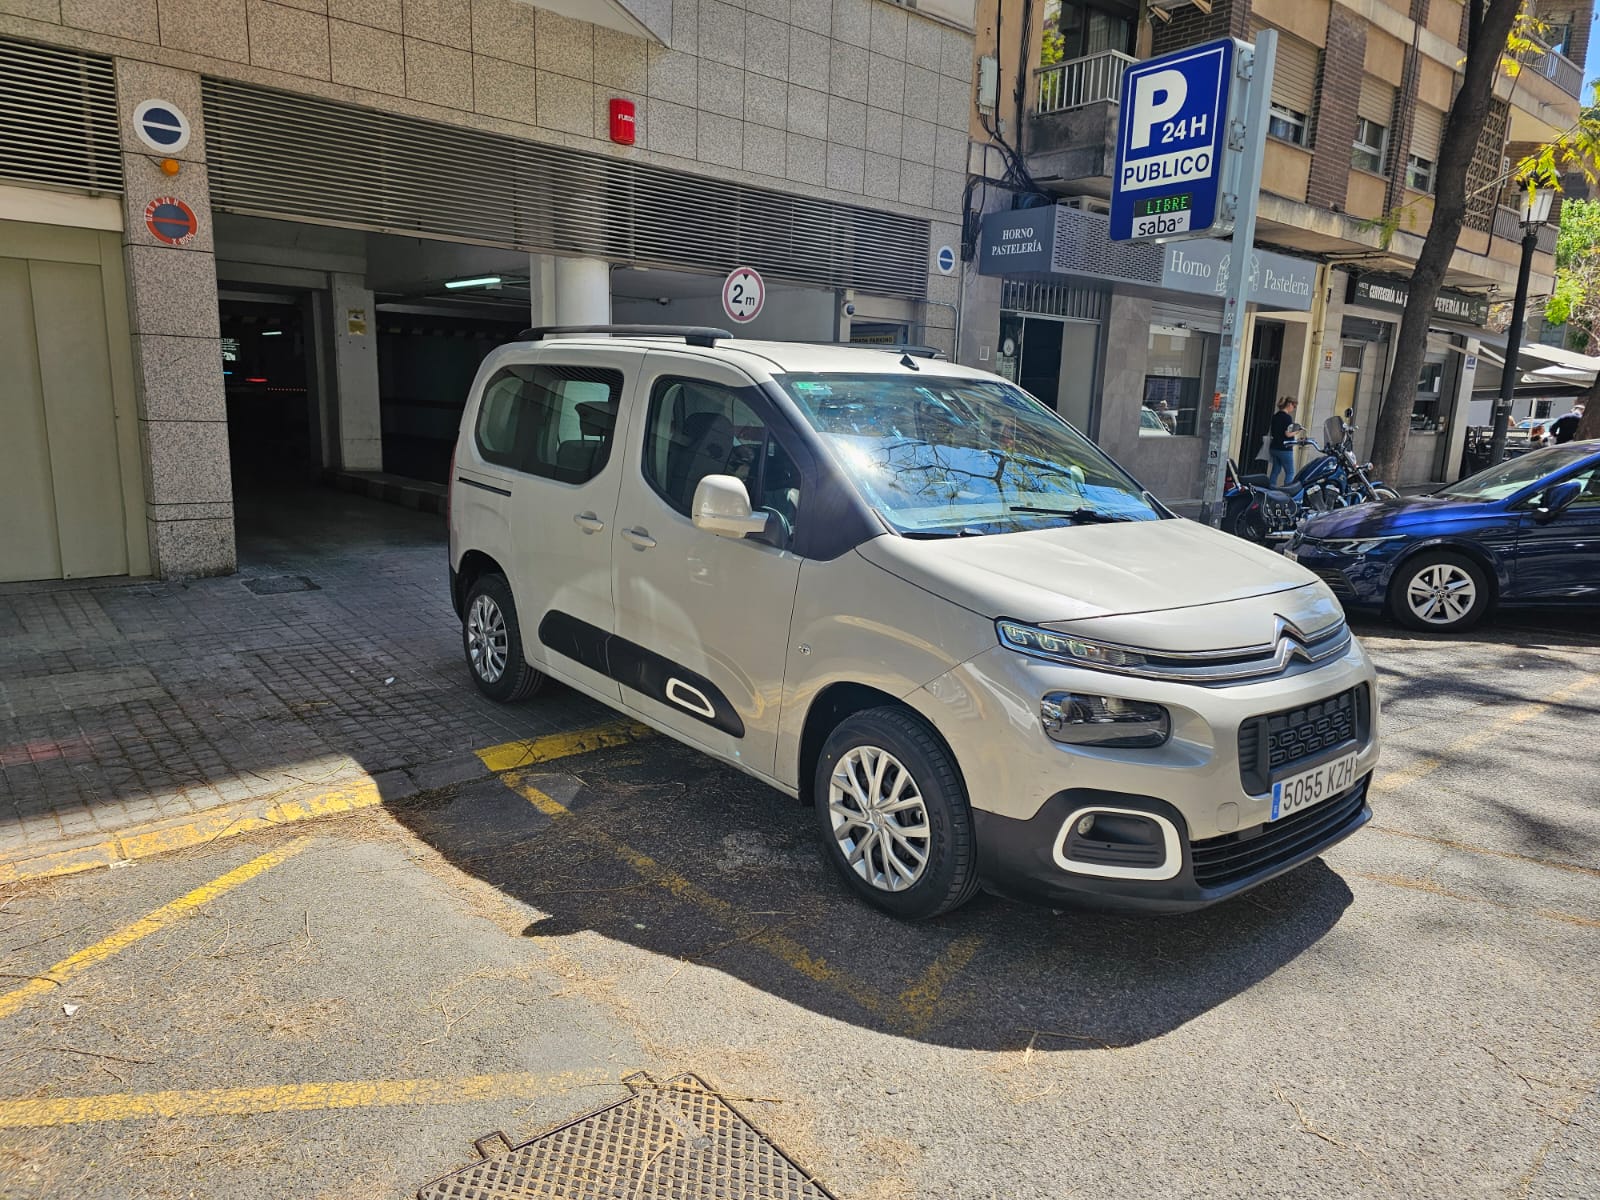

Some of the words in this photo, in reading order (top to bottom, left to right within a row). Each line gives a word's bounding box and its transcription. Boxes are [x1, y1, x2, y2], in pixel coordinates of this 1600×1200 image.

[1131, 69, 1188, 149] P
[1123, 153, 1210, 186] PUBLICO
[1146, 195, 1189, 215] LIBRE
[1002, 227, 1034, 240] HORNO
[991, 239, 1042, 256] PASTELERÍA
[1170, 250, 1211, 278] Horno
[732, 283, 744, 304] 2
[745, 296, 755, 306] m
[1283, 771, 1323, 811] 5055
[1326, 757, 1354, 794] KZH
